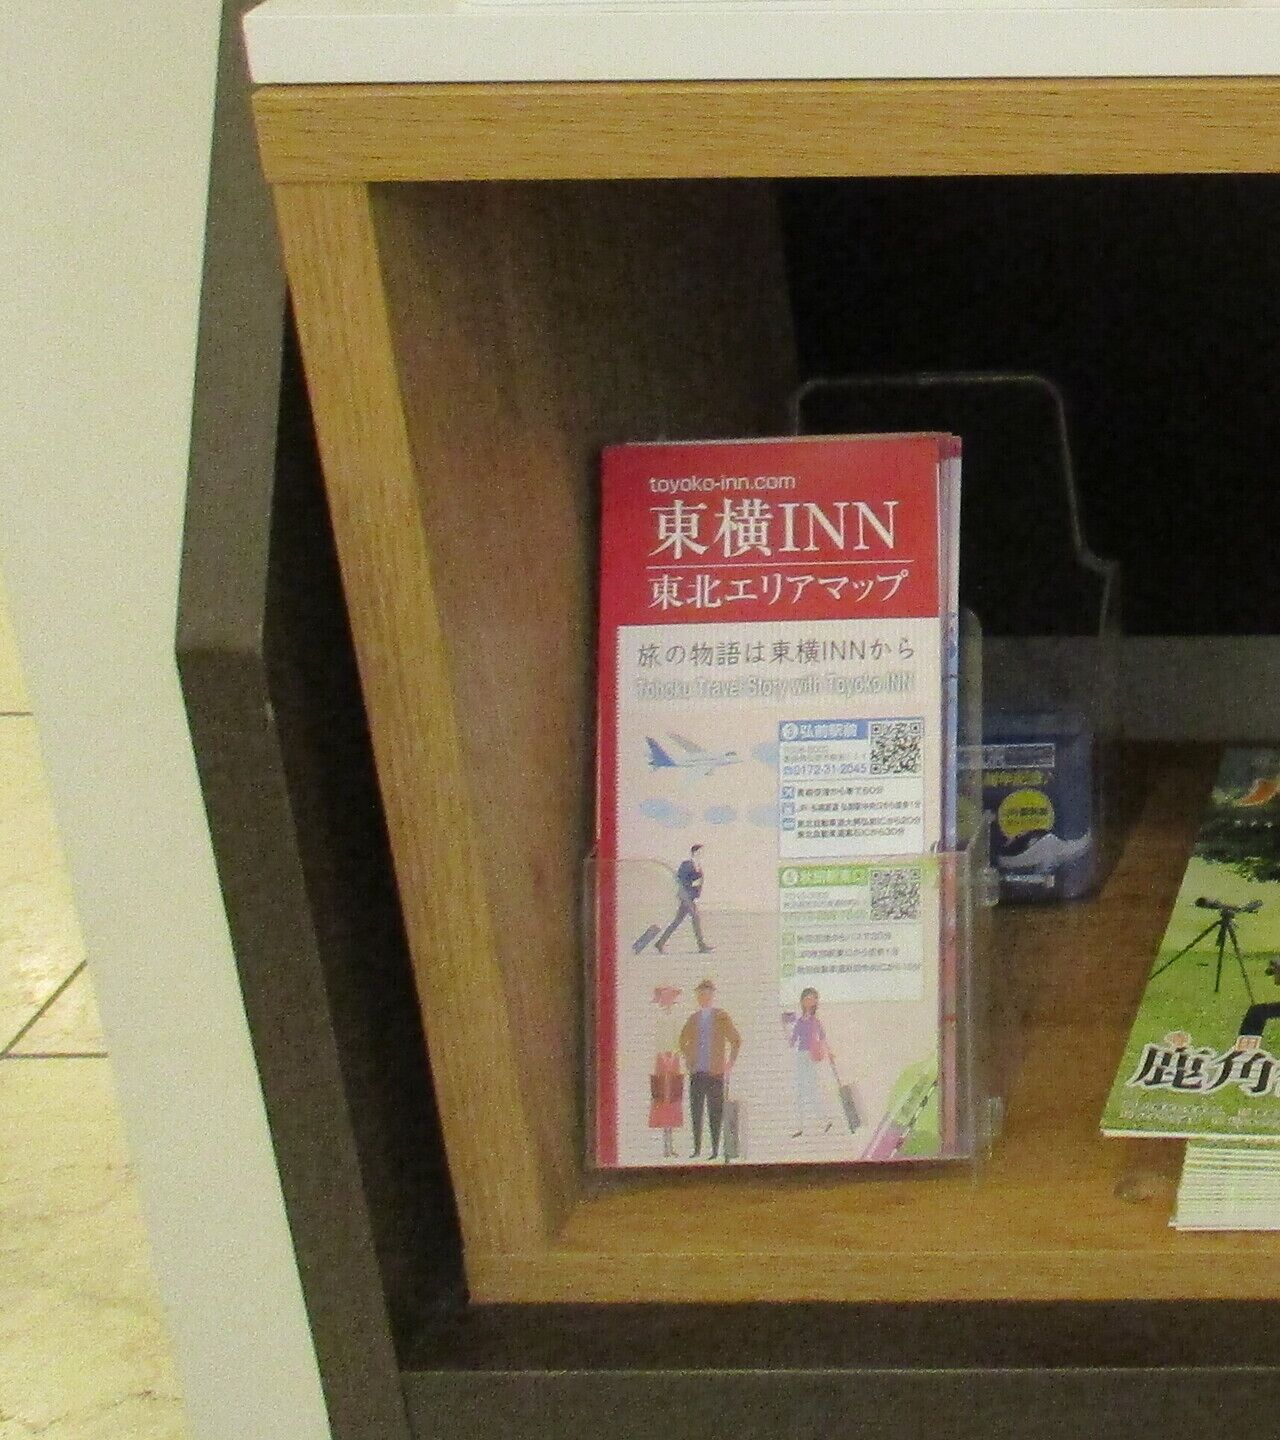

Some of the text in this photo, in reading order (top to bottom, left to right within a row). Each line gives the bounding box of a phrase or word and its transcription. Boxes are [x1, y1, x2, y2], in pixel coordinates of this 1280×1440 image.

[648, 474, 797, 494] toyoko-inn.com
[648, 497, 900, 559] 東横INN
[647, 568, 910, 611] 東北エリアマップ
[637, 637, 916, 668] 旅の物語は東横INNから
